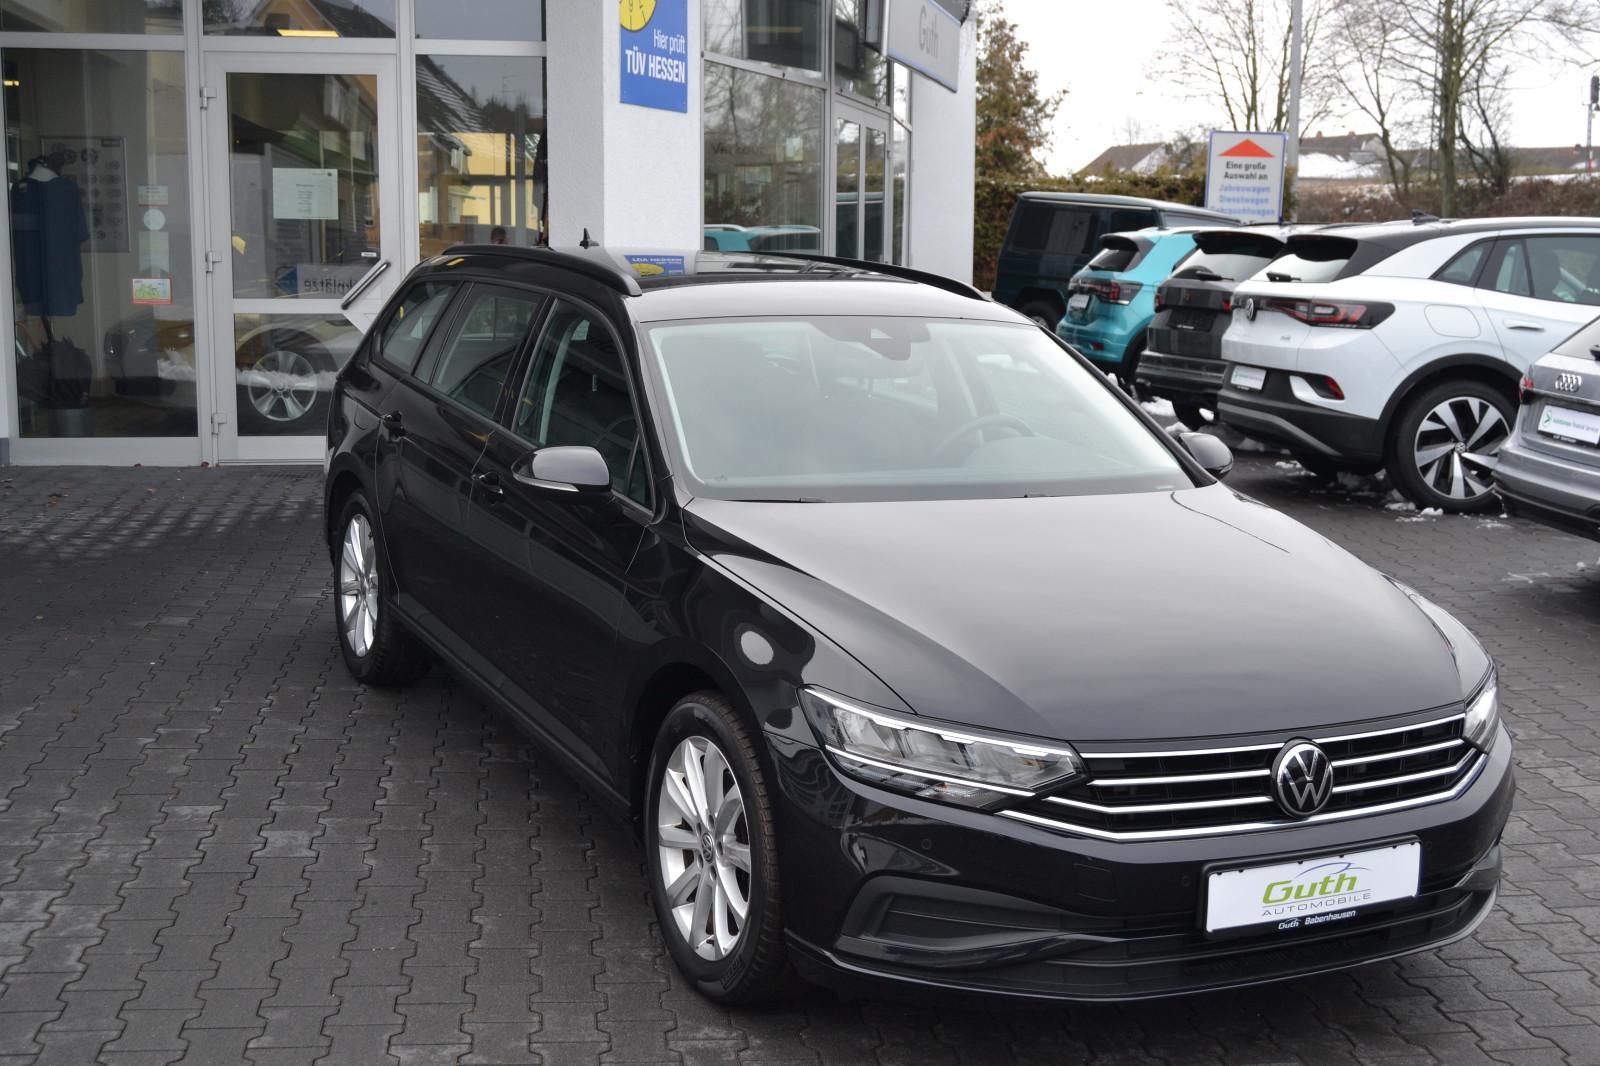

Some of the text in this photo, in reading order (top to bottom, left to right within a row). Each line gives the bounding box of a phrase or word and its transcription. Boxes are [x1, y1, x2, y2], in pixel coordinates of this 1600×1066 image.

[653, 29, 686, 55] Hier prüft
[919, 5, 938, 59] Guth
[625, 46, 686, 84] TÜV HESSEN
[1224, 172, 1257, 180] Auswahl
[1226, 161, 1267, 171] Eine große
[1219, 184, 1271, 194] Jahreswagen
[1262, 873, 1358, 905] Guth
[1261, 892, 1372, 917] AUTOMOBILE
[1278, 910, 1356, 930] Guth Babenhausen
